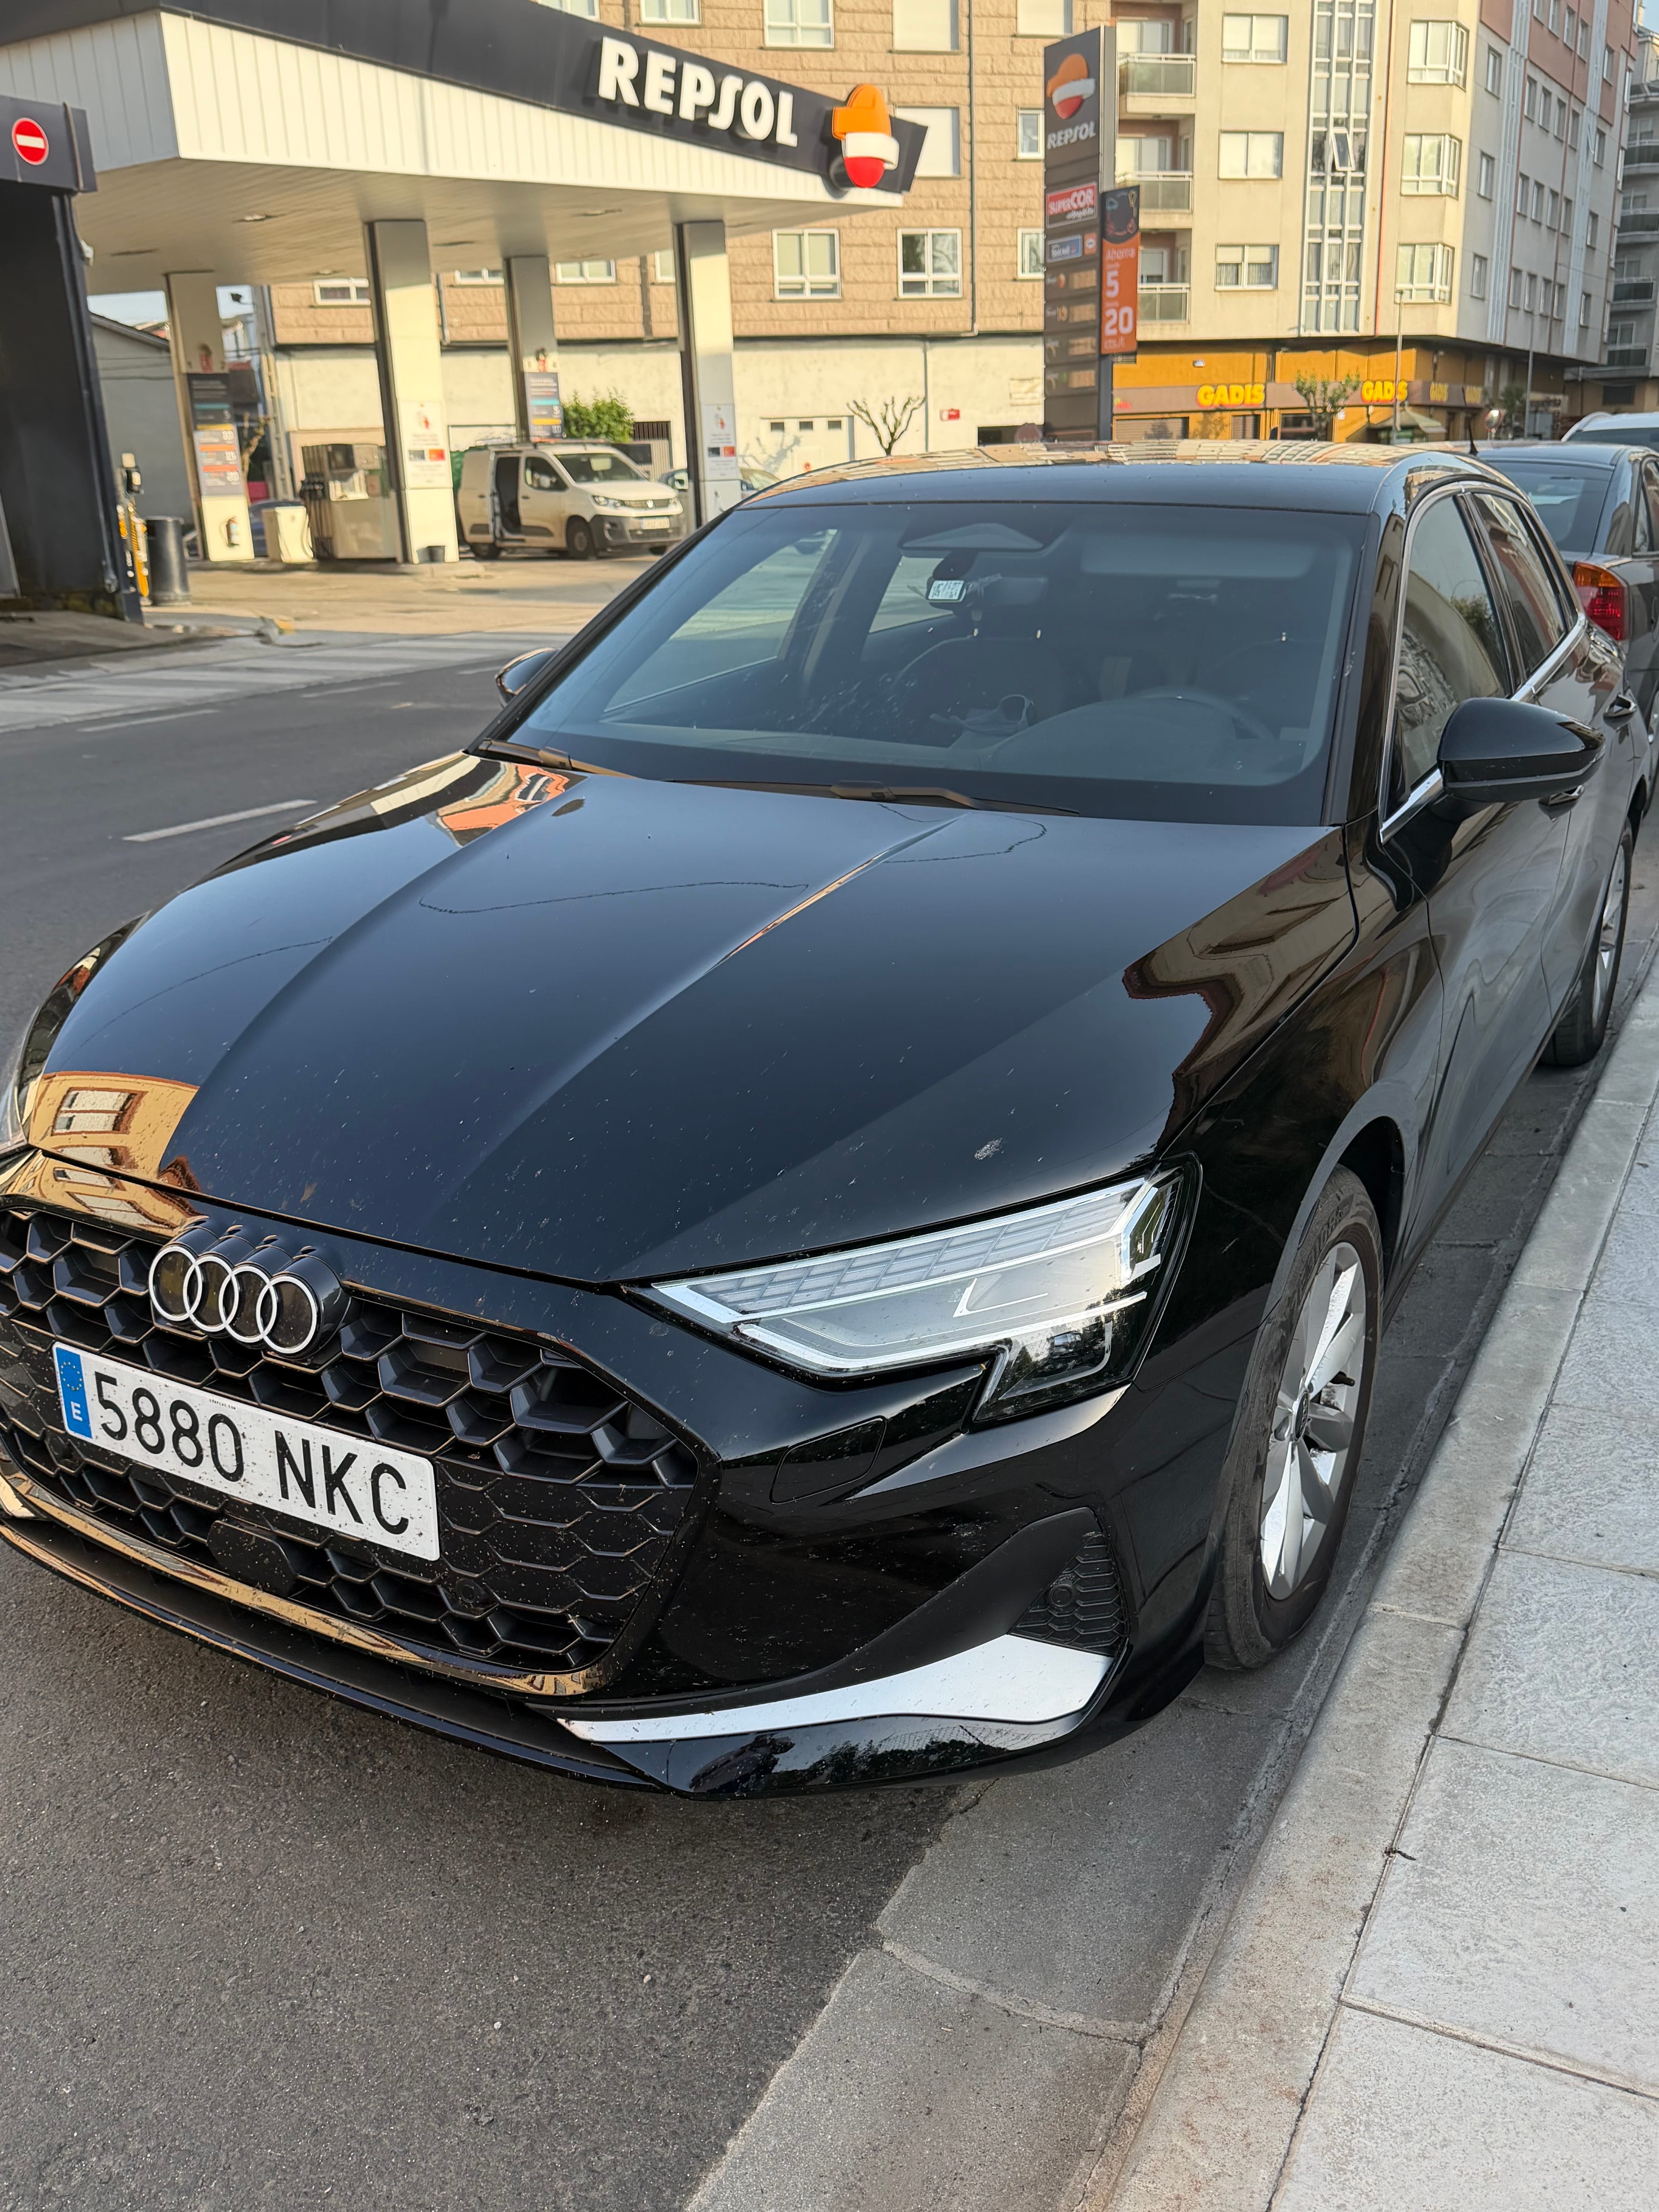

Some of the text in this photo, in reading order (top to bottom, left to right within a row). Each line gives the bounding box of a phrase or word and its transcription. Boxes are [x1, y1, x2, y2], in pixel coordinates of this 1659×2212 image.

[598, 36, 798, 148] REPSOL
[1047, 120, 1096, 149] REPSOL
[1106, 270, 1119, 298] 5
[1105, 306, 1133, 336] 20
[1196, 383, 1265, 408] GADIS
[1361, 380, 1408, 403] GADS
[70, 1401, 83, 1422] E
[94, 1371, 409, 1534] 5880 NKC
